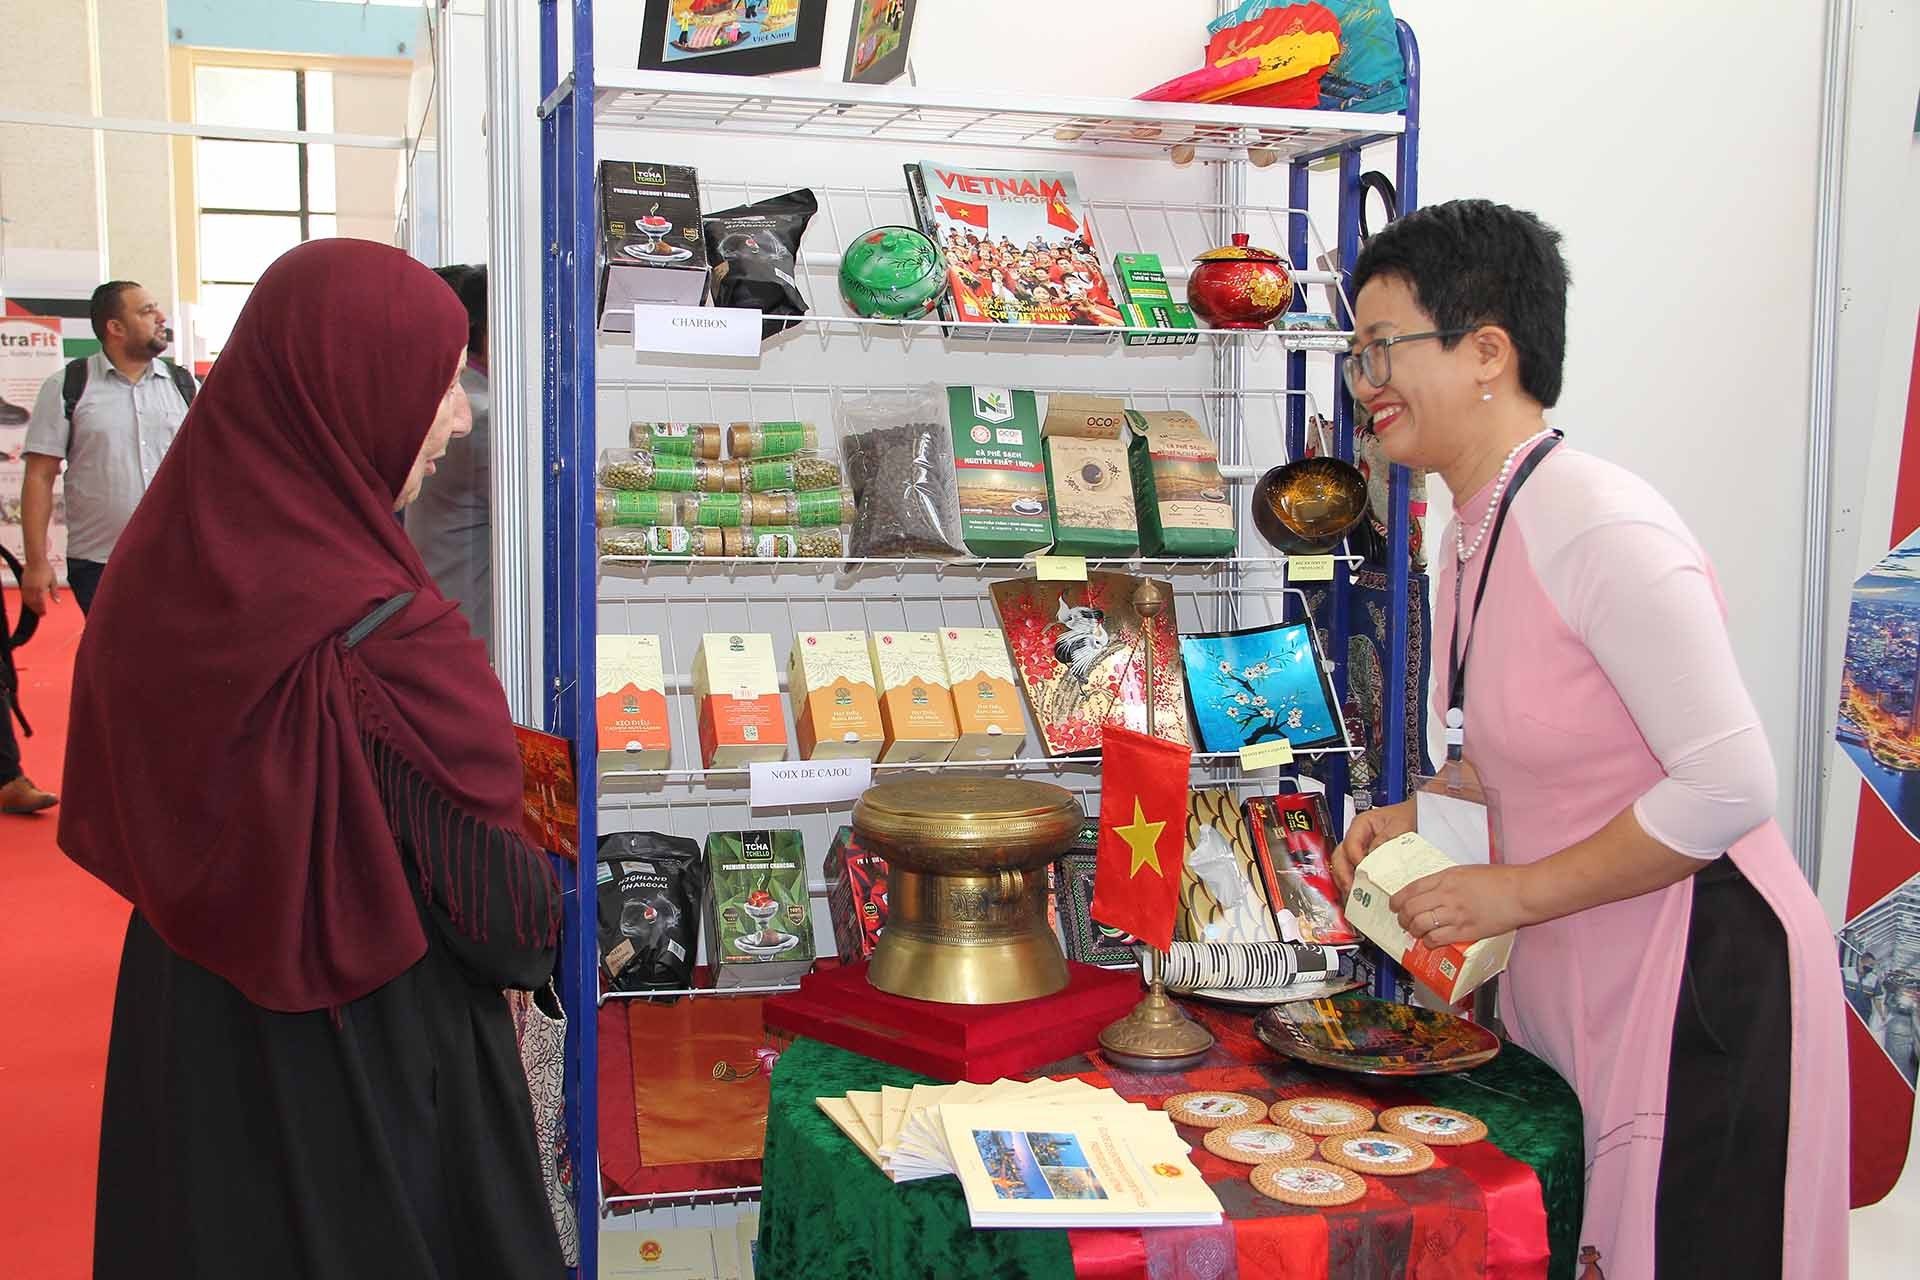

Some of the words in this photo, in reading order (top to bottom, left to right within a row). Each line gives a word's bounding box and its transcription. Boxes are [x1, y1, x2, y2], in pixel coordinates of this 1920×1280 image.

[637, 170, 662, 179] TCHA
[934, 168, 1068, 197] VIETNAM
[984, 310, 1009, 320] FOR
[672, 317, 728, 329] CHARBON
[1087, 416, 1121, 428] OCOP
[771, 769, 798, 780] NOIX
[800, 768, 816, 779] DE
[817, 767, 852, 778] CAJOU
[745, 843, 769, 851] TCHA
[722, 863, 746, 871] PREMIUM
[618, 874, 668, 886] HIGHLAND
[621, 882, 669, 893] CHARCOAL
